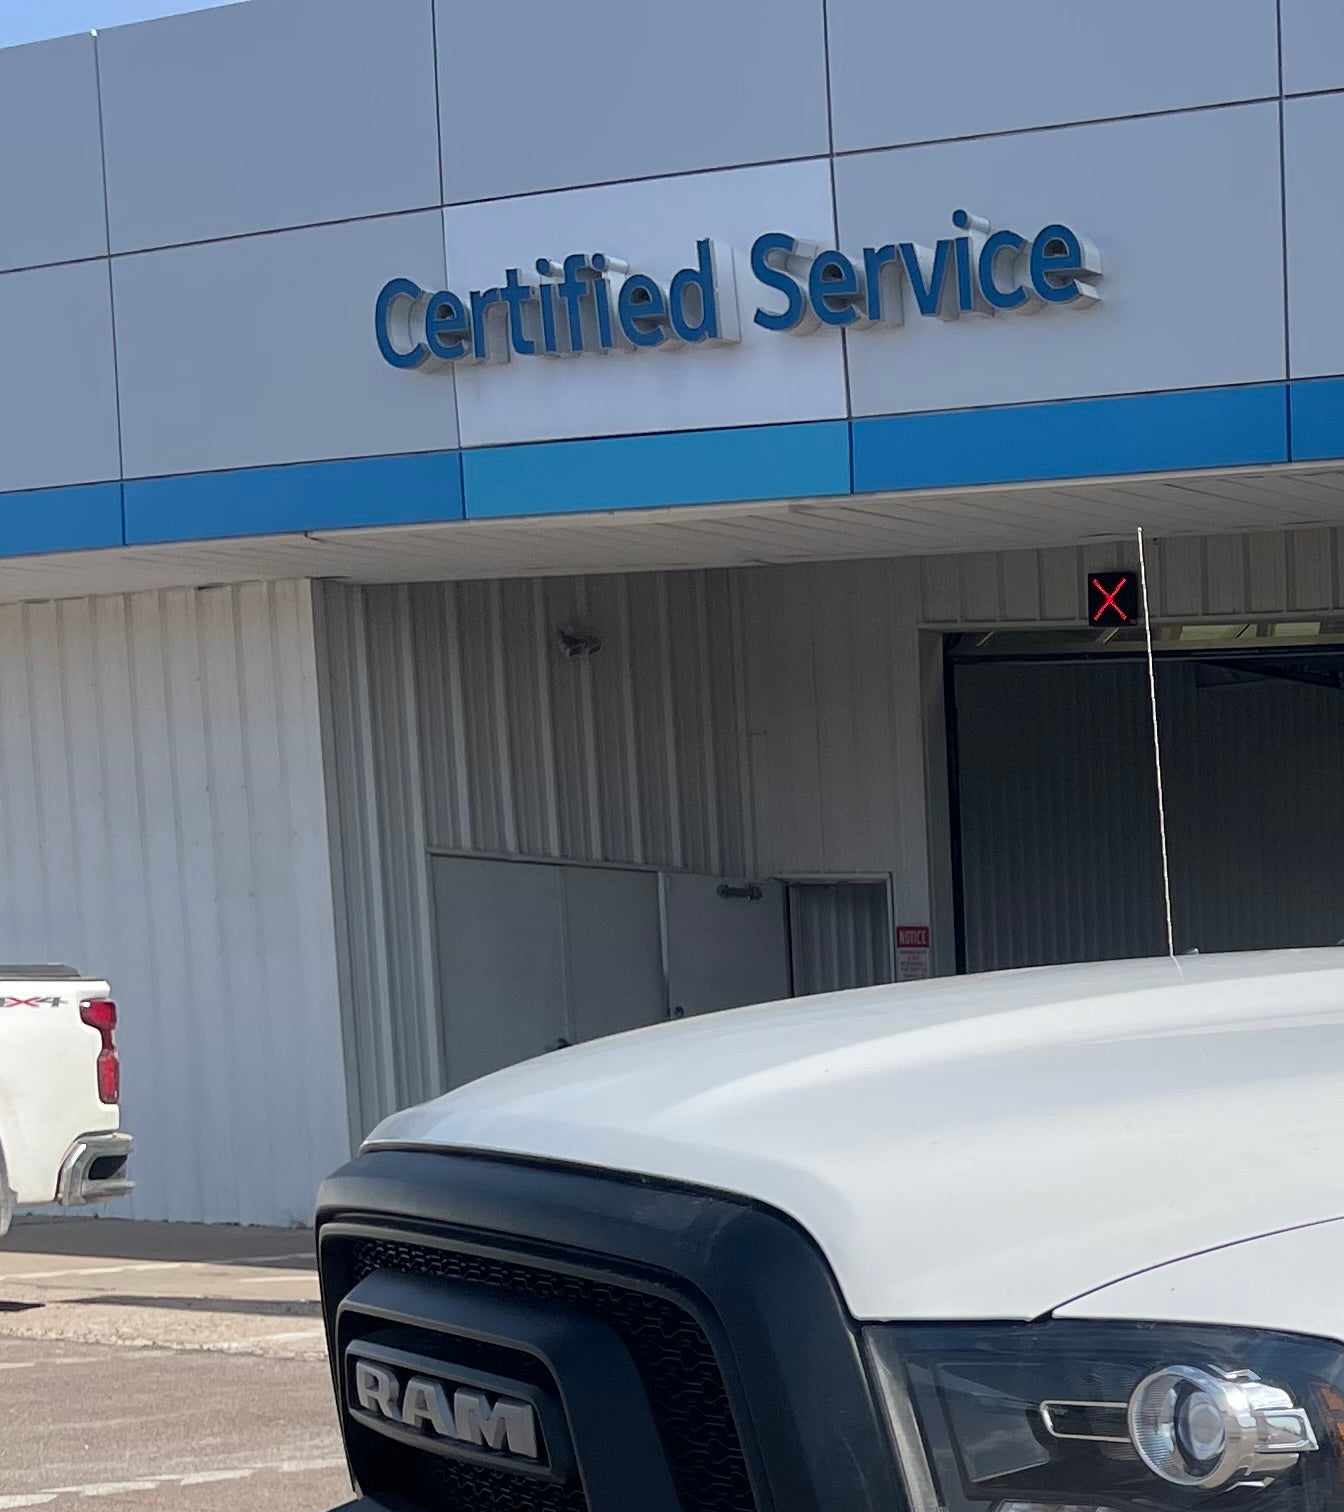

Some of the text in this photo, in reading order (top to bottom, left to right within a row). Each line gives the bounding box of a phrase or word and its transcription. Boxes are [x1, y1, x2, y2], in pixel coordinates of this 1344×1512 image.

[375, 208, 1092, 371] Certified Service
[899, 929, 927, 945] NOTICE
[356, 1358, 538, 1459] RAM
